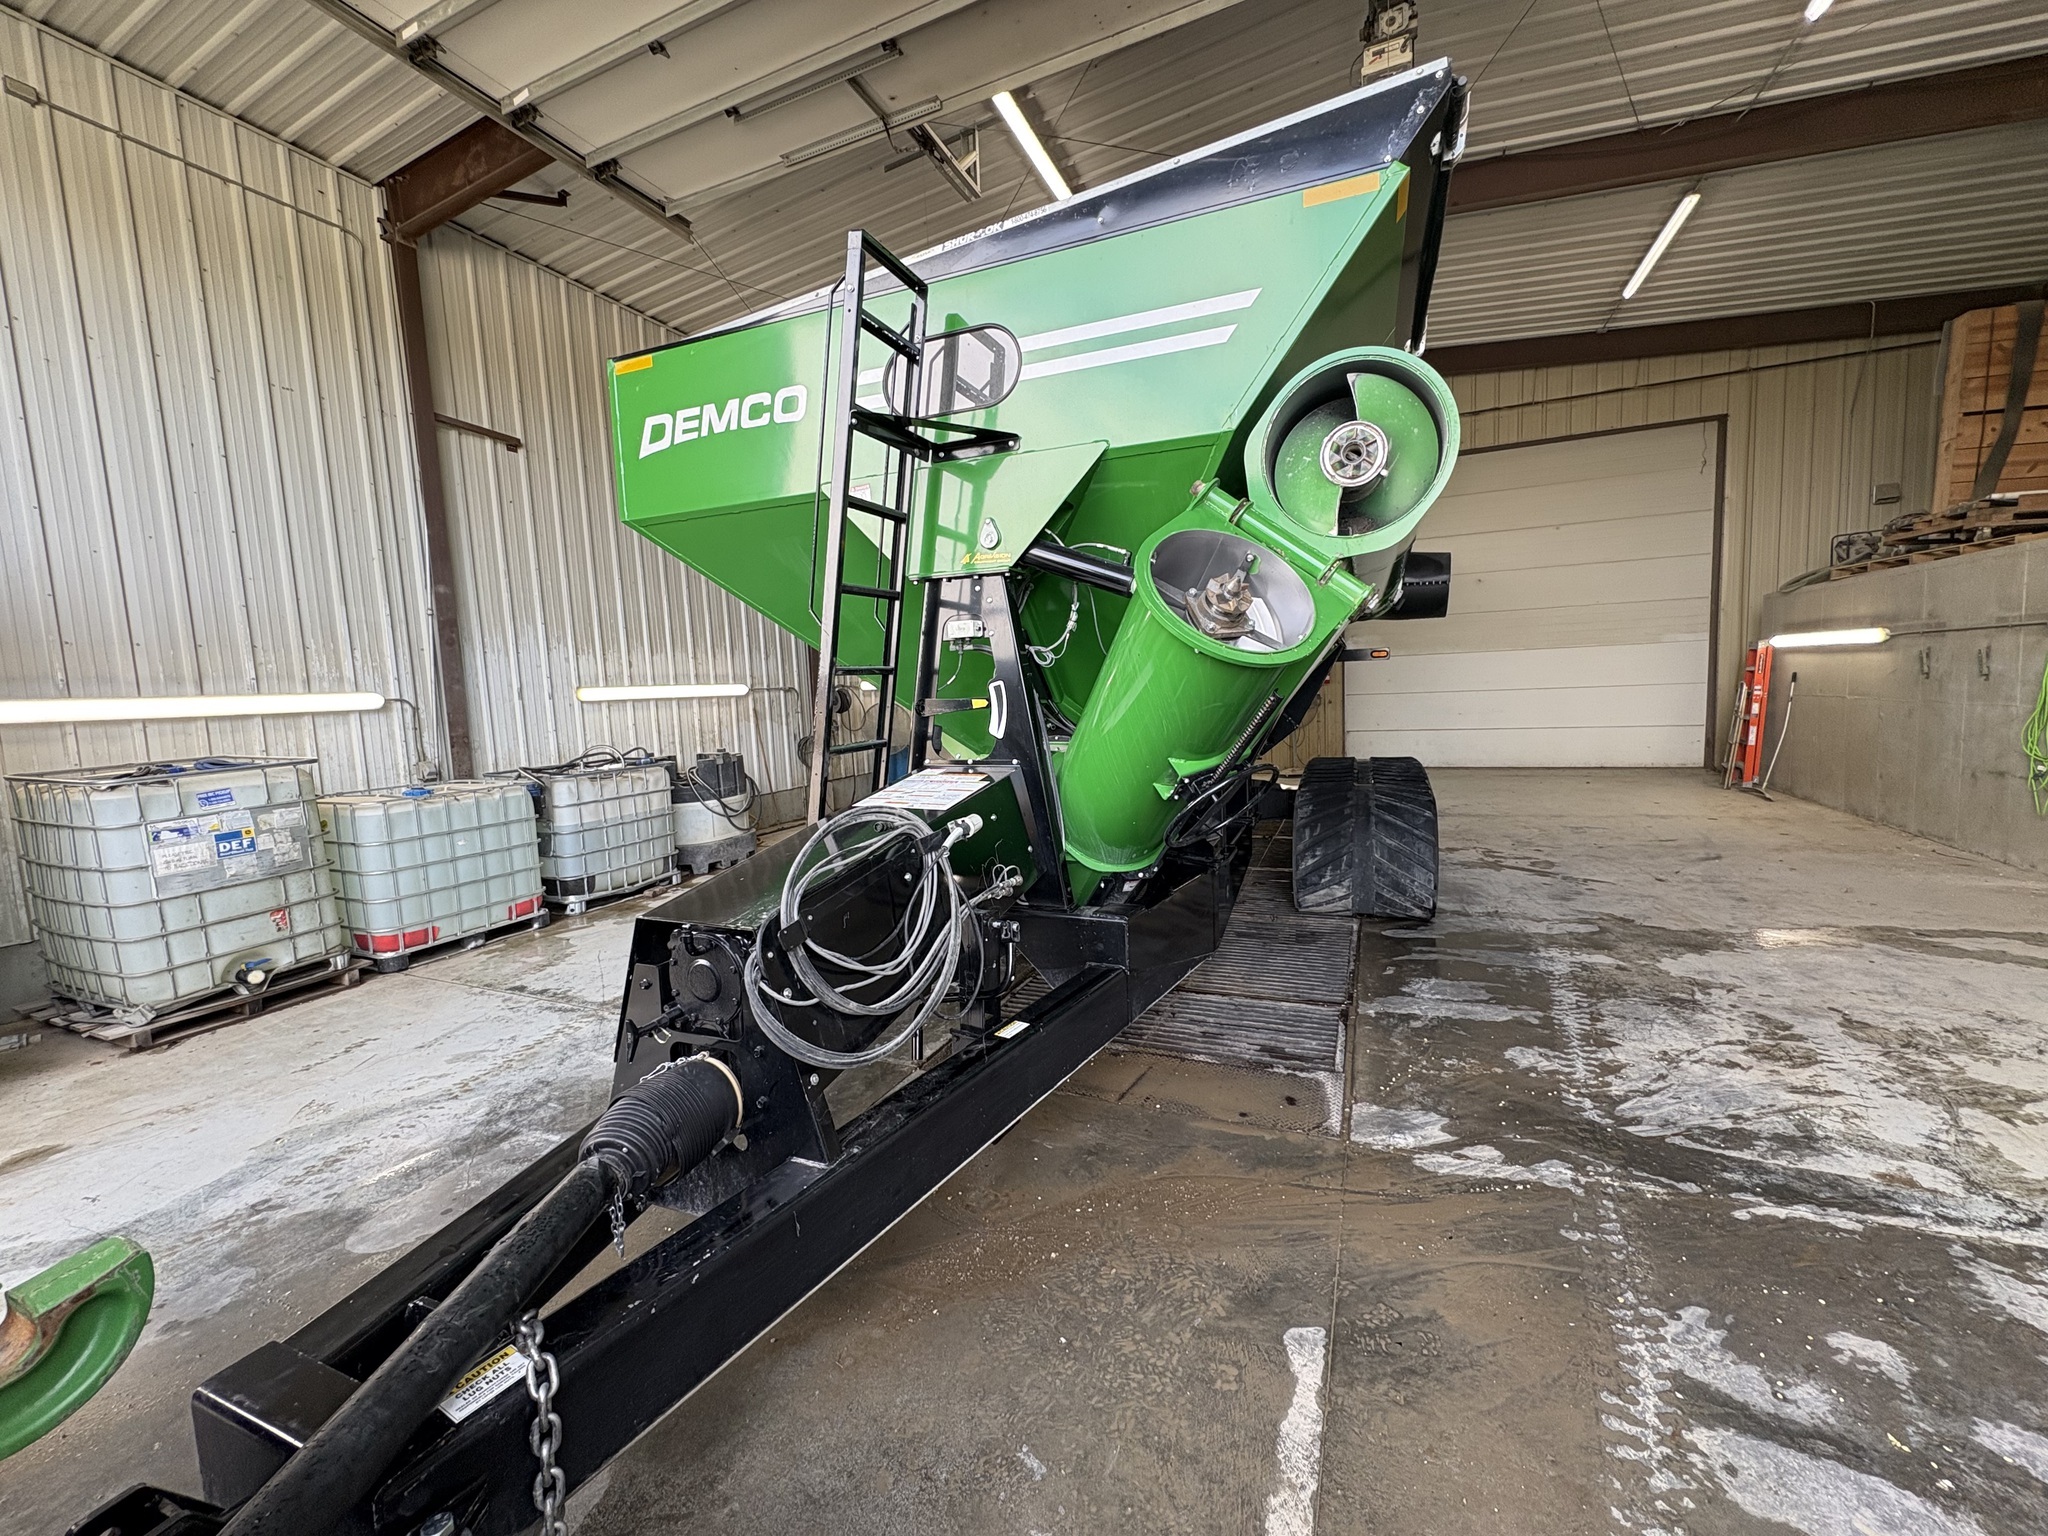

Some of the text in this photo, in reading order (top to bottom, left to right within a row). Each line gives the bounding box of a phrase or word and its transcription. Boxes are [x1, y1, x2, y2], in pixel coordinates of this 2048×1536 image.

[639, 385, 808, 460] DEMCO
[219, 838, 253, 853] DEF
[455, 1351, 510, 1390] CAUTION
[455, 1361, 511, 1400] CHECK ALL
[462, 1366, 512, 1402] LUG NUTS
